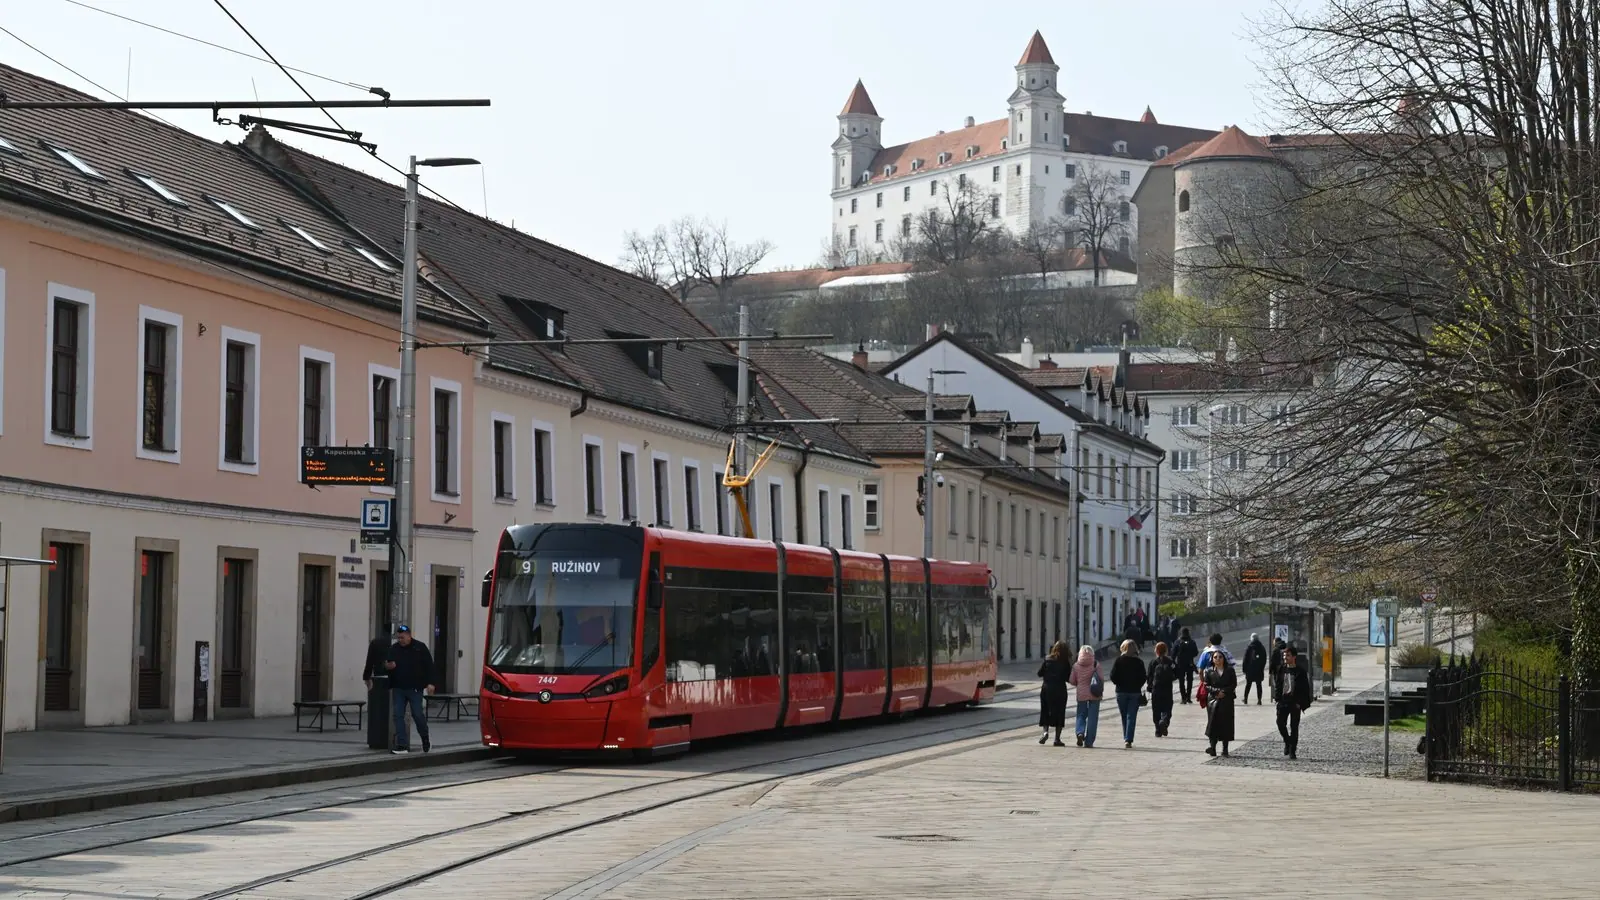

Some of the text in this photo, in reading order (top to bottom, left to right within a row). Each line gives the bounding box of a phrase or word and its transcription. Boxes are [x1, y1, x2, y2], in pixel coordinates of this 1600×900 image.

[522, 560, 601, 573] 9 RUŽINOV
[537, 675, 558, 684] 7447
